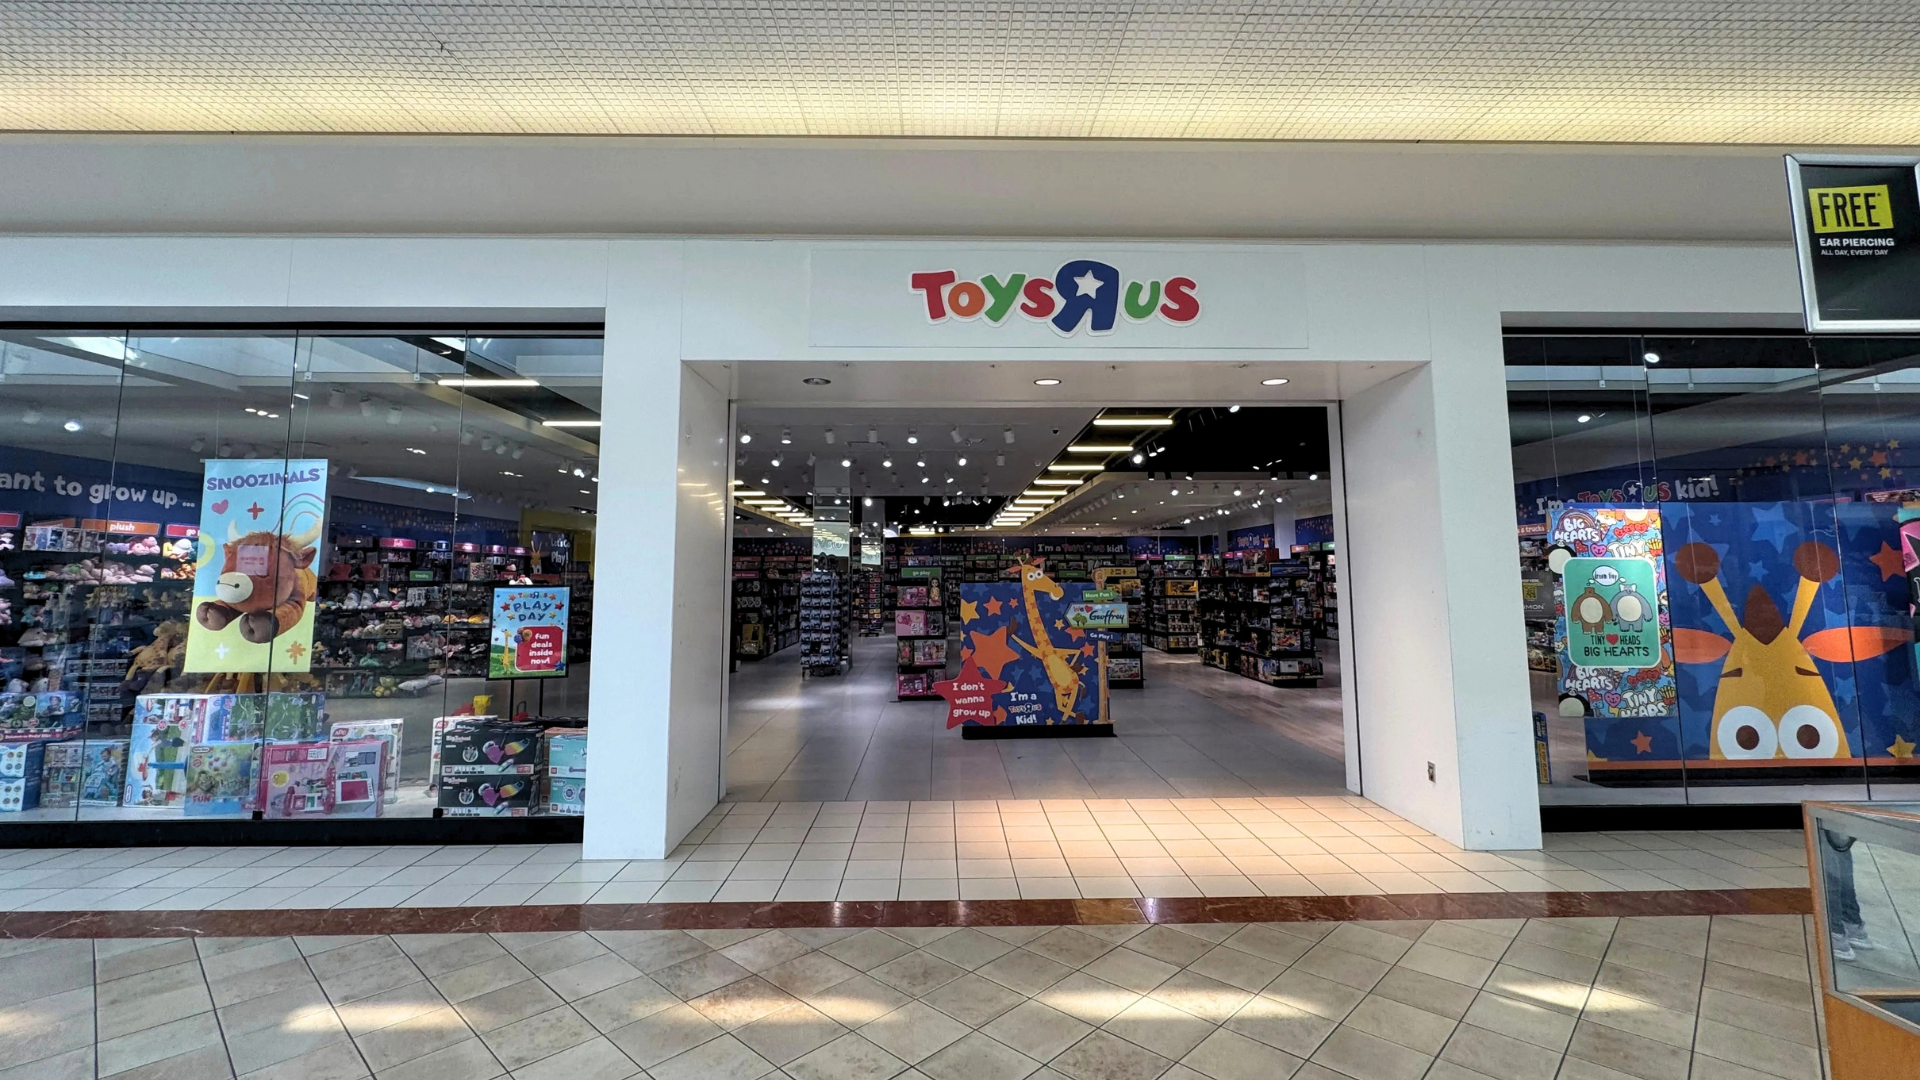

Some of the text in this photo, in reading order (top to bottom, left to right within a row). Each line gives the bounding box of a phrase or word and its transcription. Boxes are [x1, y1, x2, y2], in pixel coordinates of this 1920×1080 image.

[1819, 238, 1895, 247] EAR PIERCING
[54, 475, 82, 496] to
[88, 484, 147, 504] grow
[1536, 496, 1564, 515] I'm
[1674, 475, 1720, 500] kid!
[110, 522, 135, 532] plush
[1564, 518, 1584, 532] BIG
[1554, 528, 1600, 542] HEARTS
[1038, 544, 1054, 552] I'm
[1106, 544, 1124, 553] kid!
[1608, 540, 1646, 558] TINY
[512, 600, 552, 612] PLAY
[518, 612, 546, 622] DAY
[1090, 610, 1124, 624] Geoffrey
[1590, 635, 1641, 645] TINY HEADS
[1584, 647, 1650, 656] BIG HEARTS
[1576, 666, 1597, 680] BIG
[952, 682, 985, 690] I don't
[1566, 676, 1613, 690] HEARTS
[954, 696, 984, 704] wanna
[1010, 692, 1028, 701] I'm
[1622, 688, 1656, 708] TINY
[952, 708, 990, 718] grow up
[1016, 714, 1038, 725] Kid!
[192, 795, 211, 803] FUN
